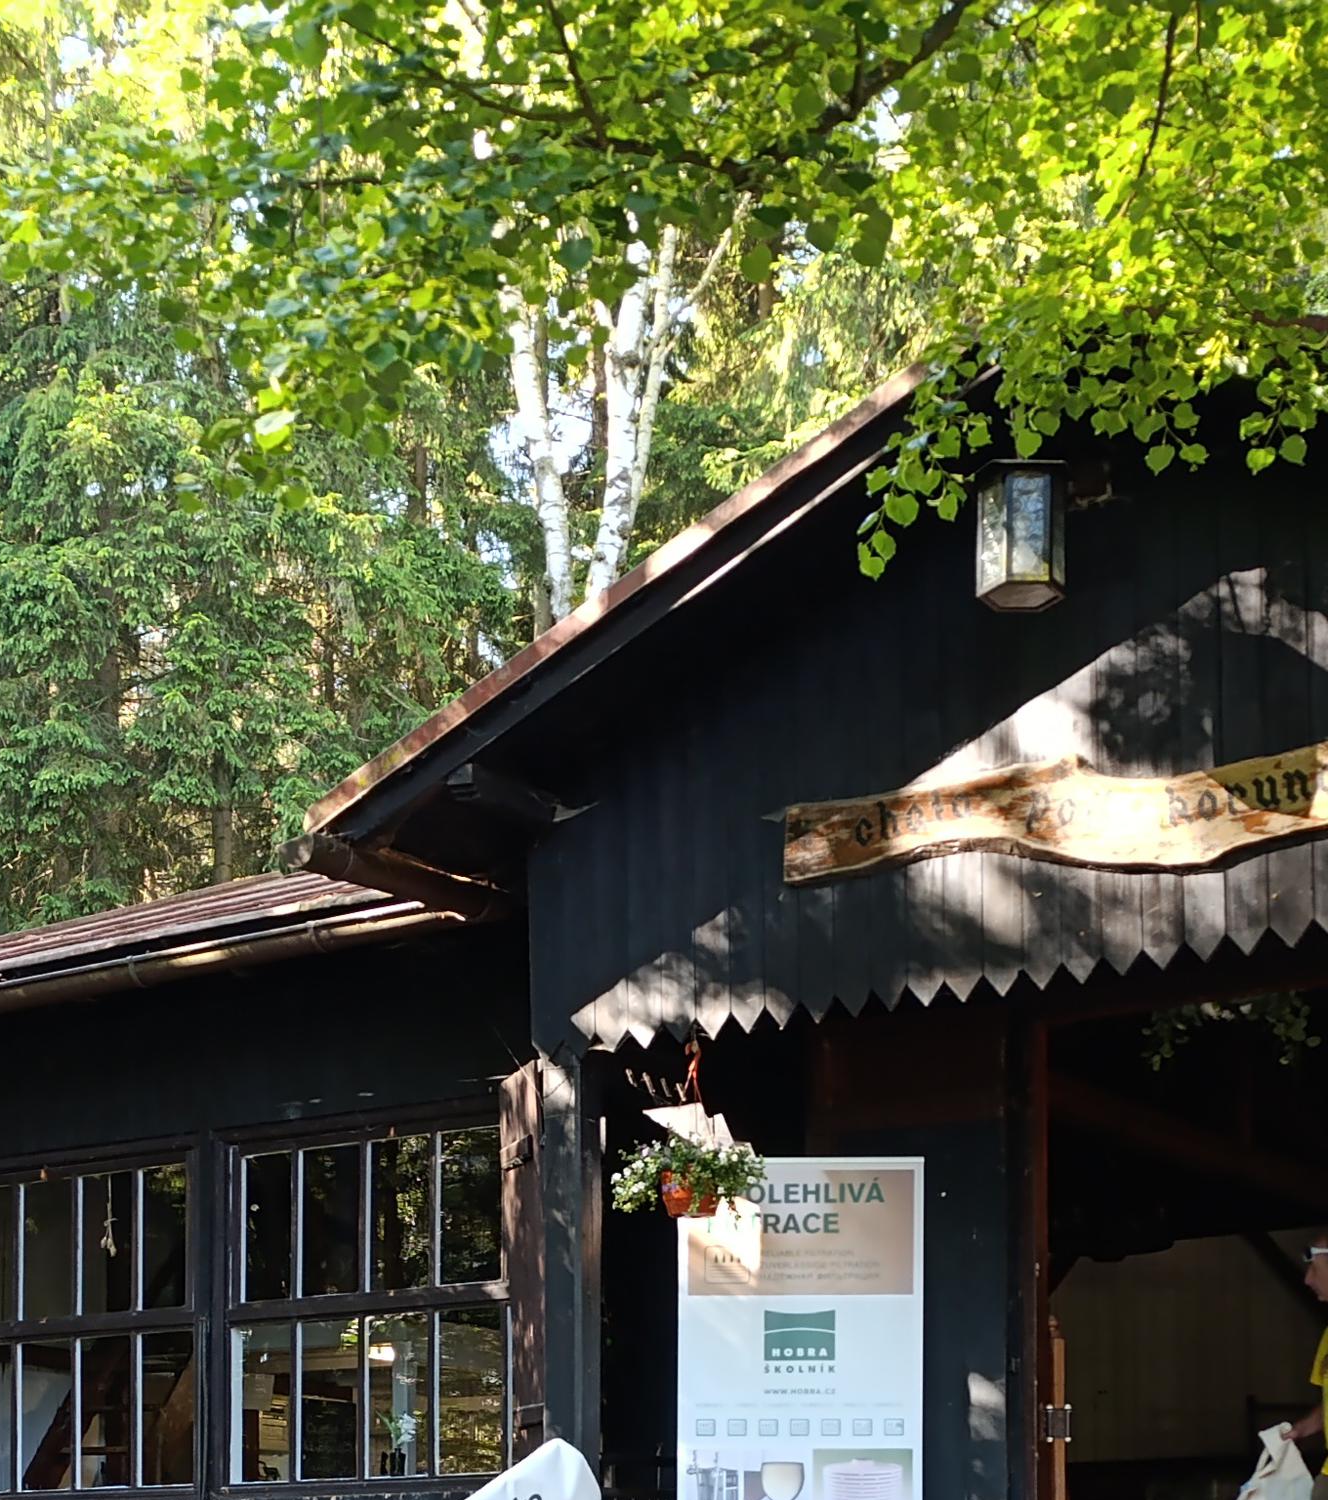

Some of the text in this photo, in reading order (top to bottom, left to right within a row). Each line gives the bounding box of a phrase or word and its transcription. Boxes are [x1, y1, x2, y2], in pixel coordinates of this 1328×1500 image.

[744, 1177, 885, 1204] OLEHLIVÁ
[756, 1212, 840, 1235] RACE
[771, 1347, 828, 1357] HOBRA
[763, 1363, 836, 1374] ŠKOLNÍK
